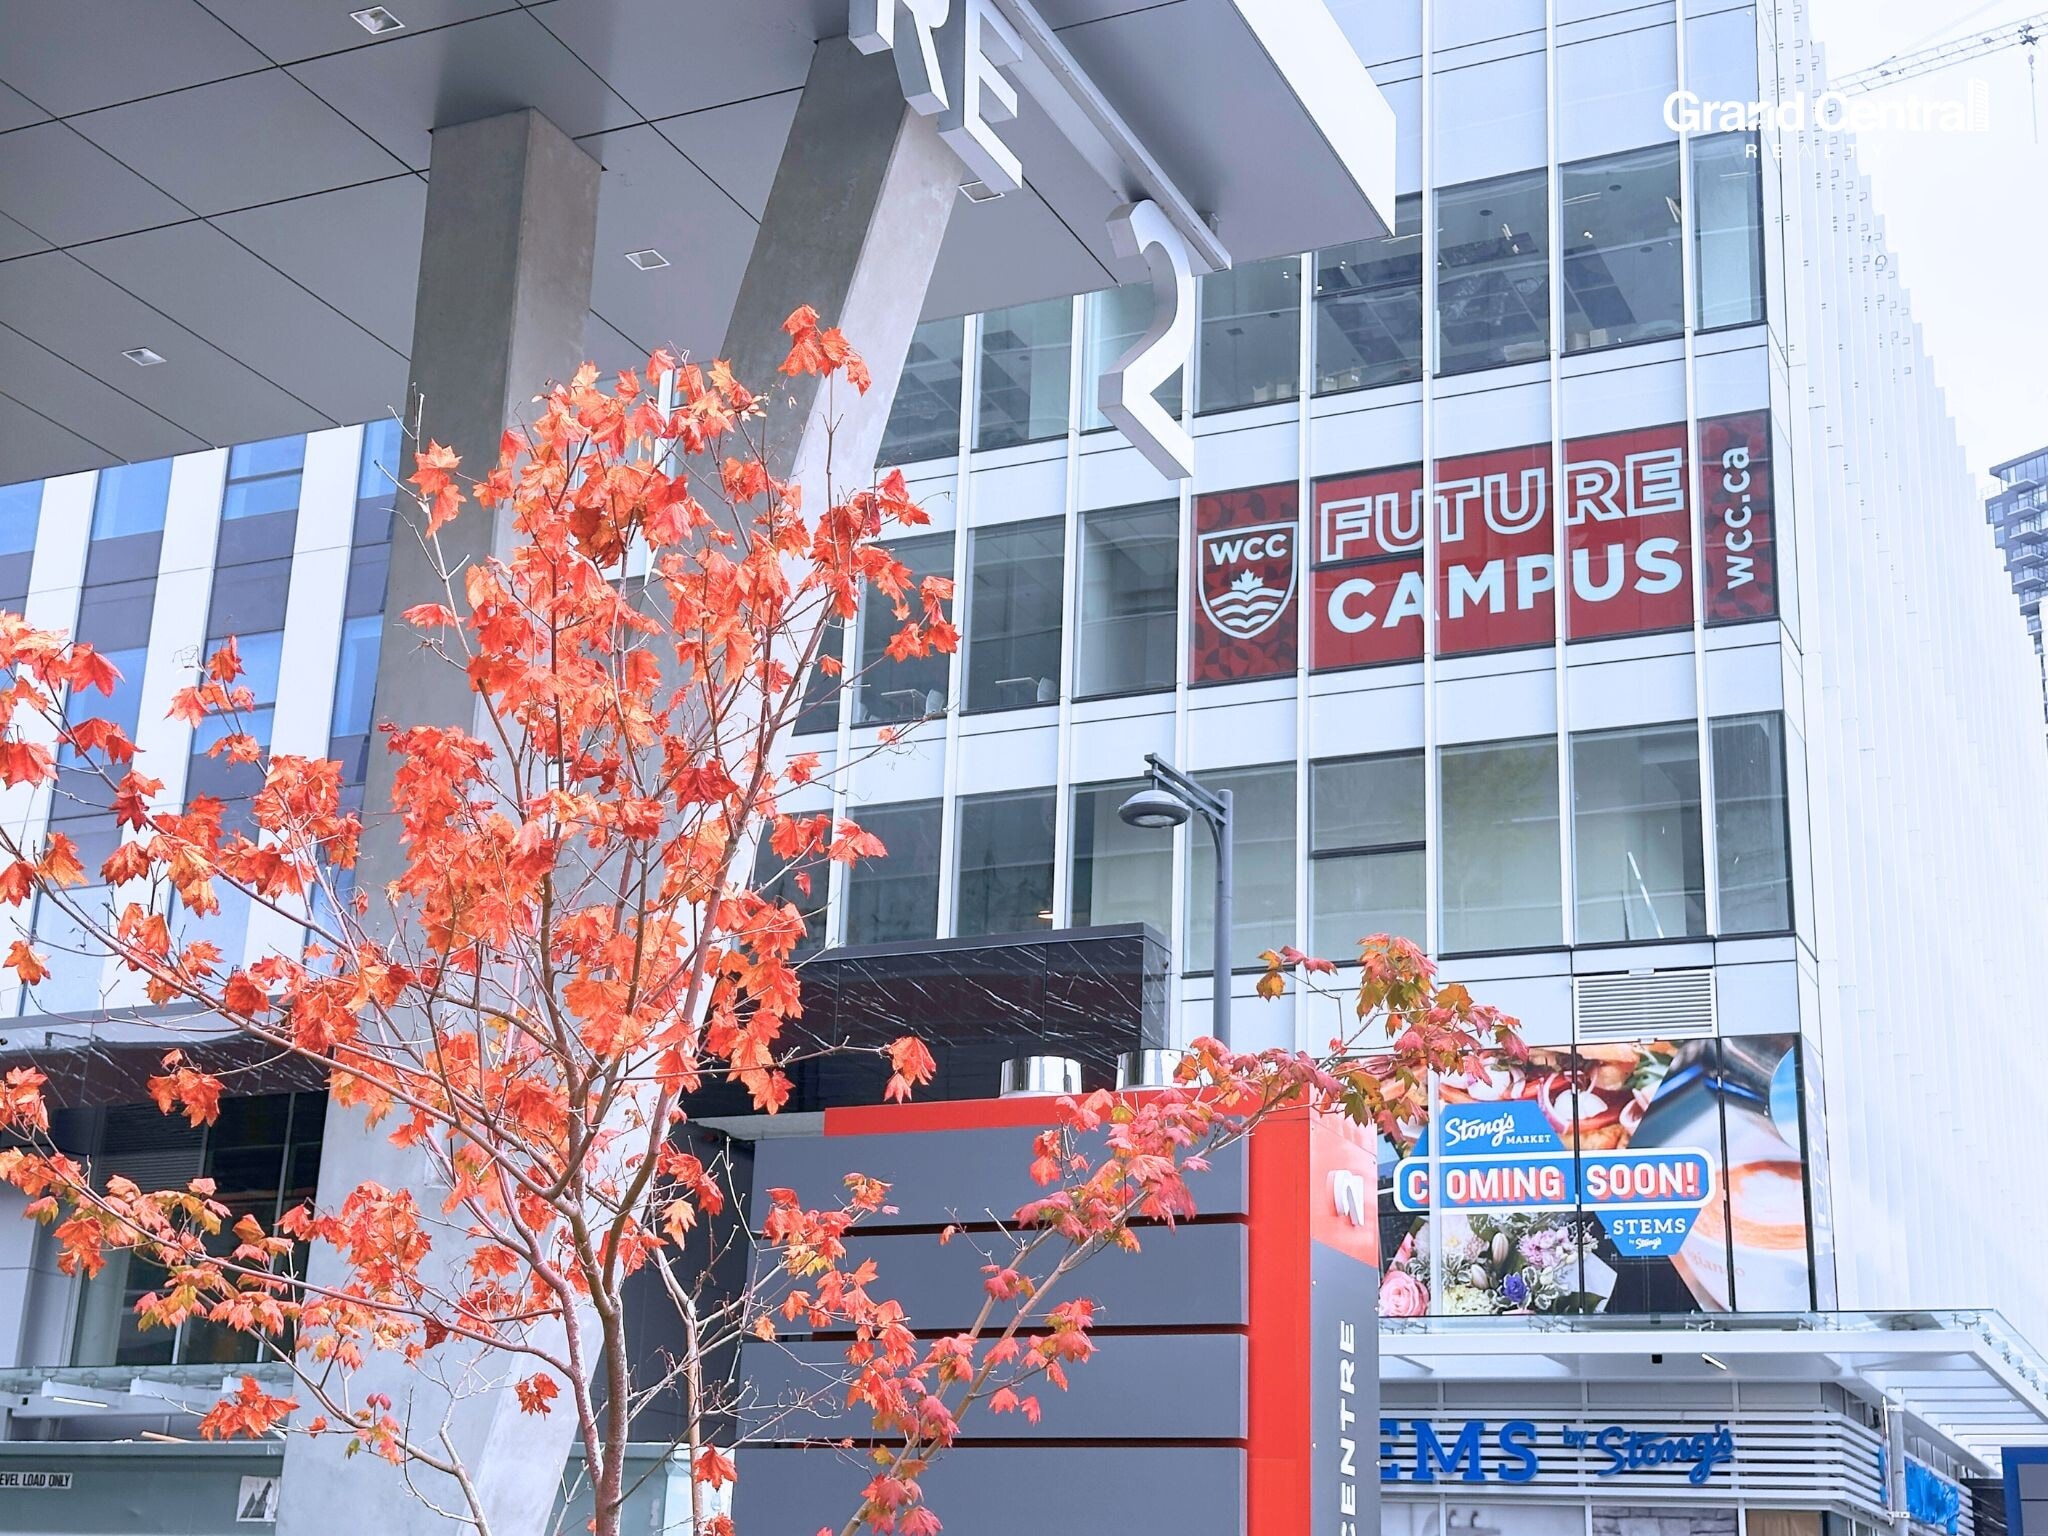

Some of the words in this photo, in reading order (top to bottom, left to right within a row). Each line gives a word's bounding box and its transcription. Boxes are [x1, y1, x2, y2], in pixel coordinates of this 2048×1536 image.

[1320, 447, 1685, 563] FUTURE
[1722, 446, 1755, 590] wcc.ca
[1209, 534, 1288, 566] WCC
[1327, 536, 1684, 634] CAMPUS
[1444, 1112, 1515, 1147] Stong's
[1506, 1134, 1551, 1145] MARKET
[1407, 1165, 1564, 1203] COMING
[1586, 1162, 1699, 1200] SOON!
[1612, 1217, 1686, 1235] STEMS
[1562, 1424, 1588, 1451] by
[1596, 1423, 1735, 1486] Stong's
[22, 1473, 46, 1487] LOAD
[48, 1474, 71, 1487] ONLY
